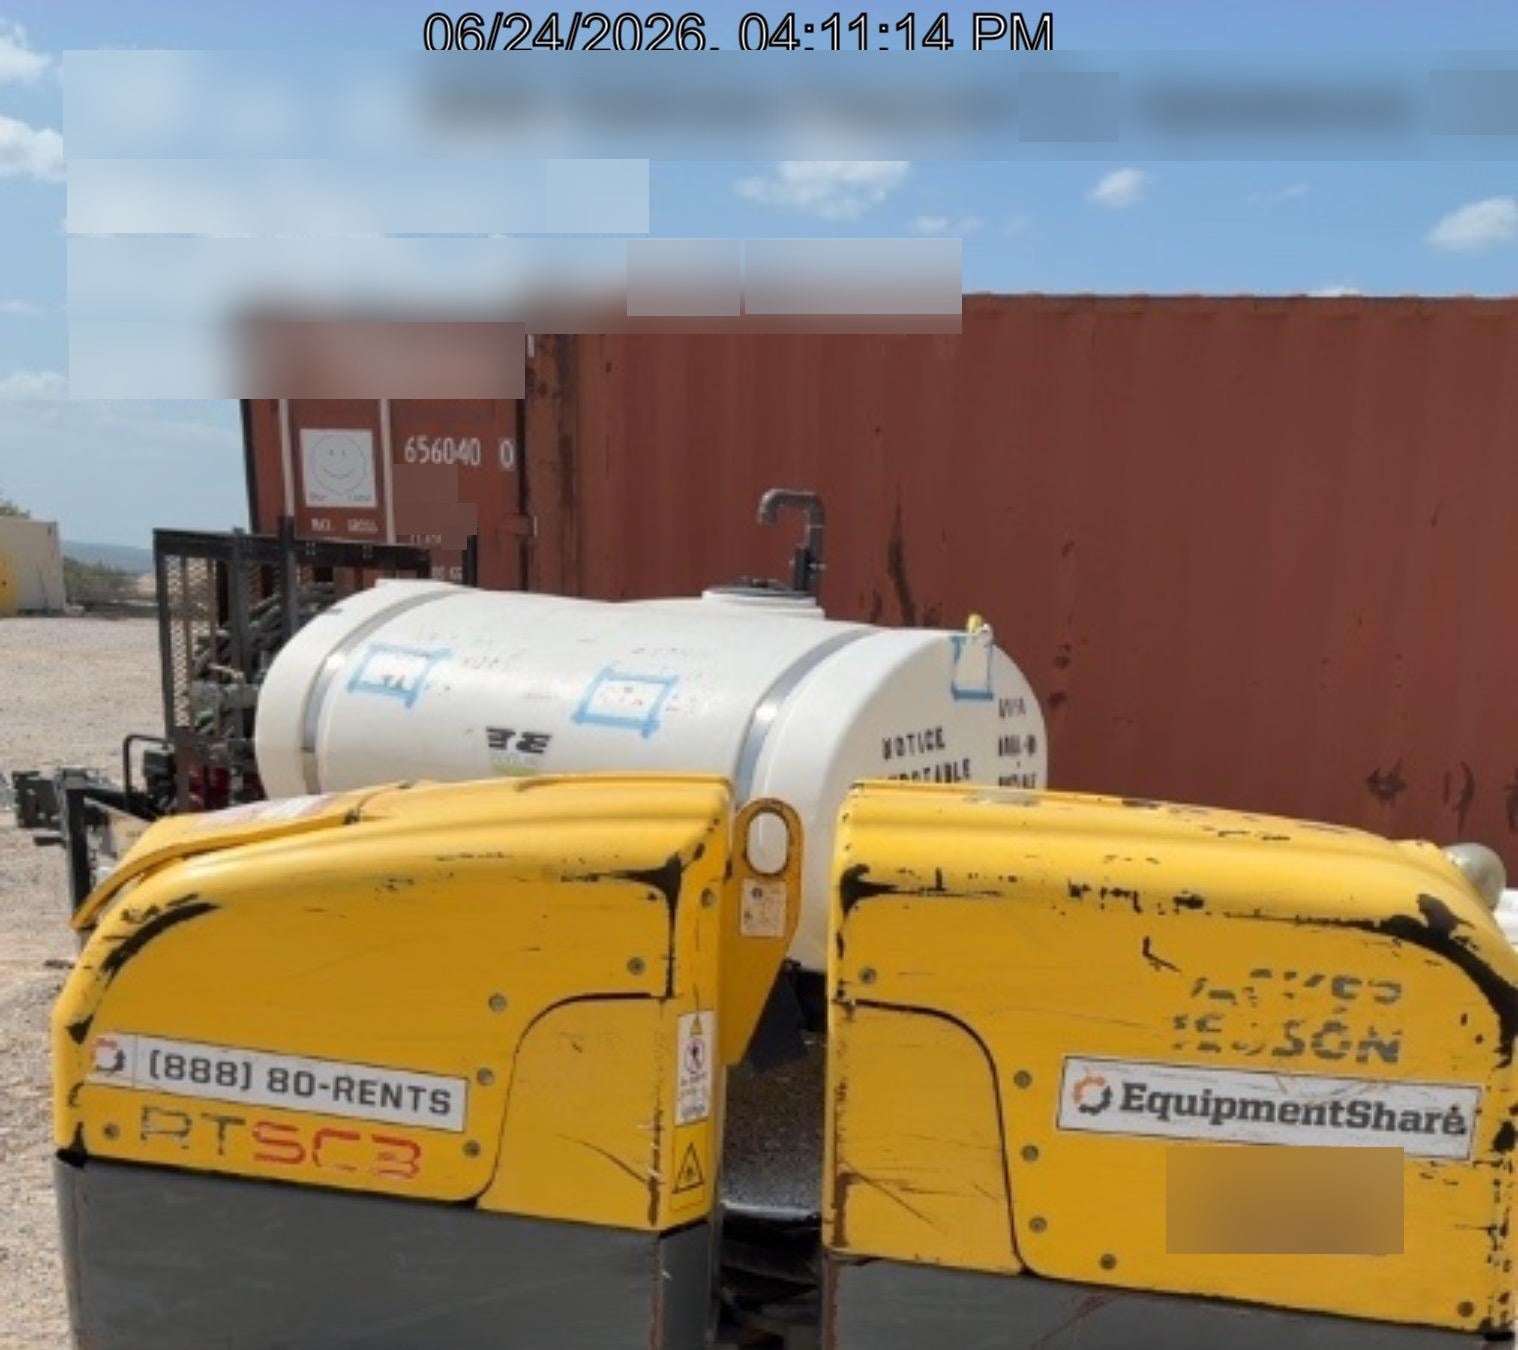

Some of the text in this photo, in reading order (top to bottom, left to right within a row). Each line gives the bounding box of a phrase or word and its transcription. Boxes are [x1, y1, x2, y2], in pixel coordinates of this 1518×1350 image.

[404, 435, 515, 471] 656040 0
[882, 727, 945, 761] NOTICE
[149, 1049, 453, 1116] (888) 80-RENTS
[1119, 1082, 1467, 1136] EquipmentShare
